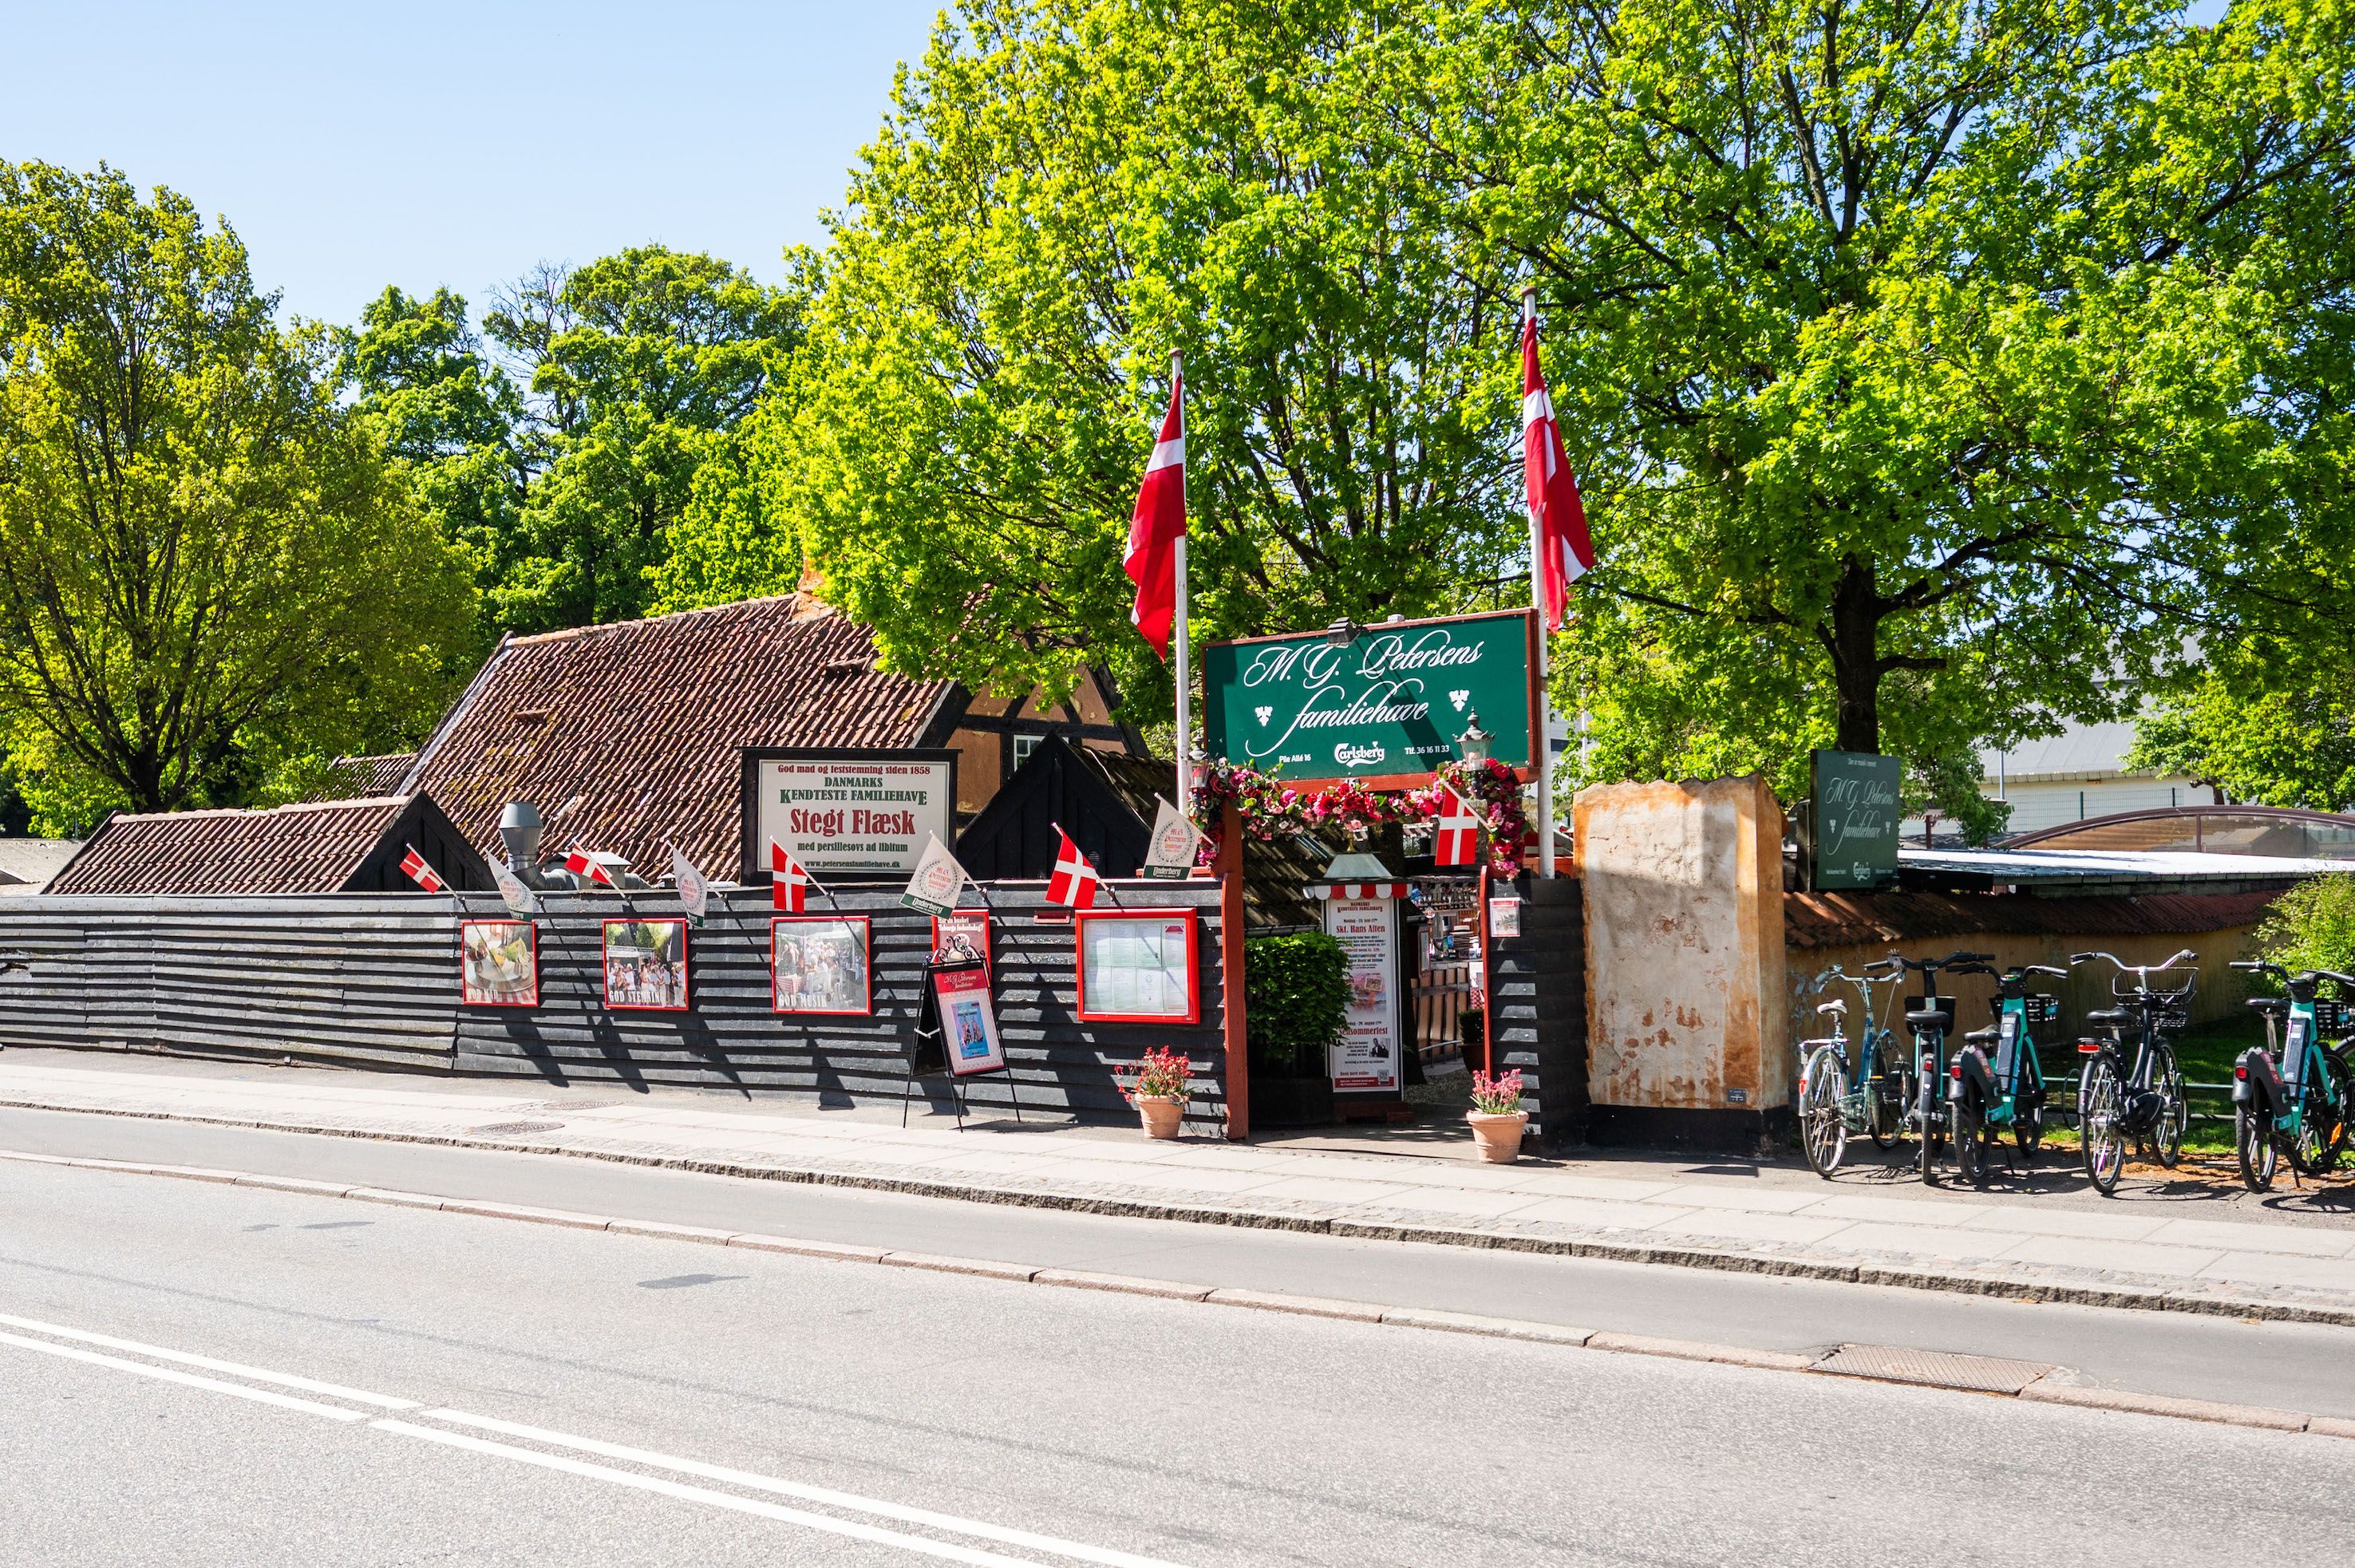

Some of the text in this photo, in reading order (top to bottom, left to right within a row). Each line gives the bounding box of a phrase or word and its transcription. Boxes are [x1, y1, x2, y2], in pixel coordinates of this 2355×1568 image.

[1243, 630, 1484, 689] M. G. Petersens
[1245, 678, 1428, 756] familiehave
[1334, 741, 1385, 768] Carlsberg
[1440, 745, 1450, 753] 33
[777, 764, 795, 773] God
[831, 765, 883, 775] feststemning
[824, 777, 883, 788] DANMARKS
[780, 789, 927, 805] KENDTESTE FAMILIEHAVE
[790, 808, 916, 837] Stegt Flæsk
[797, 842, 908, 852] med persillesovs ad libitum
[1153, 867, 1181, 877] Underberg
[911, 898, 943, 914] Underberg
[609, 990, 625, 1002] GOD
[778, 994, 828, 1007] GOD MUSIK
